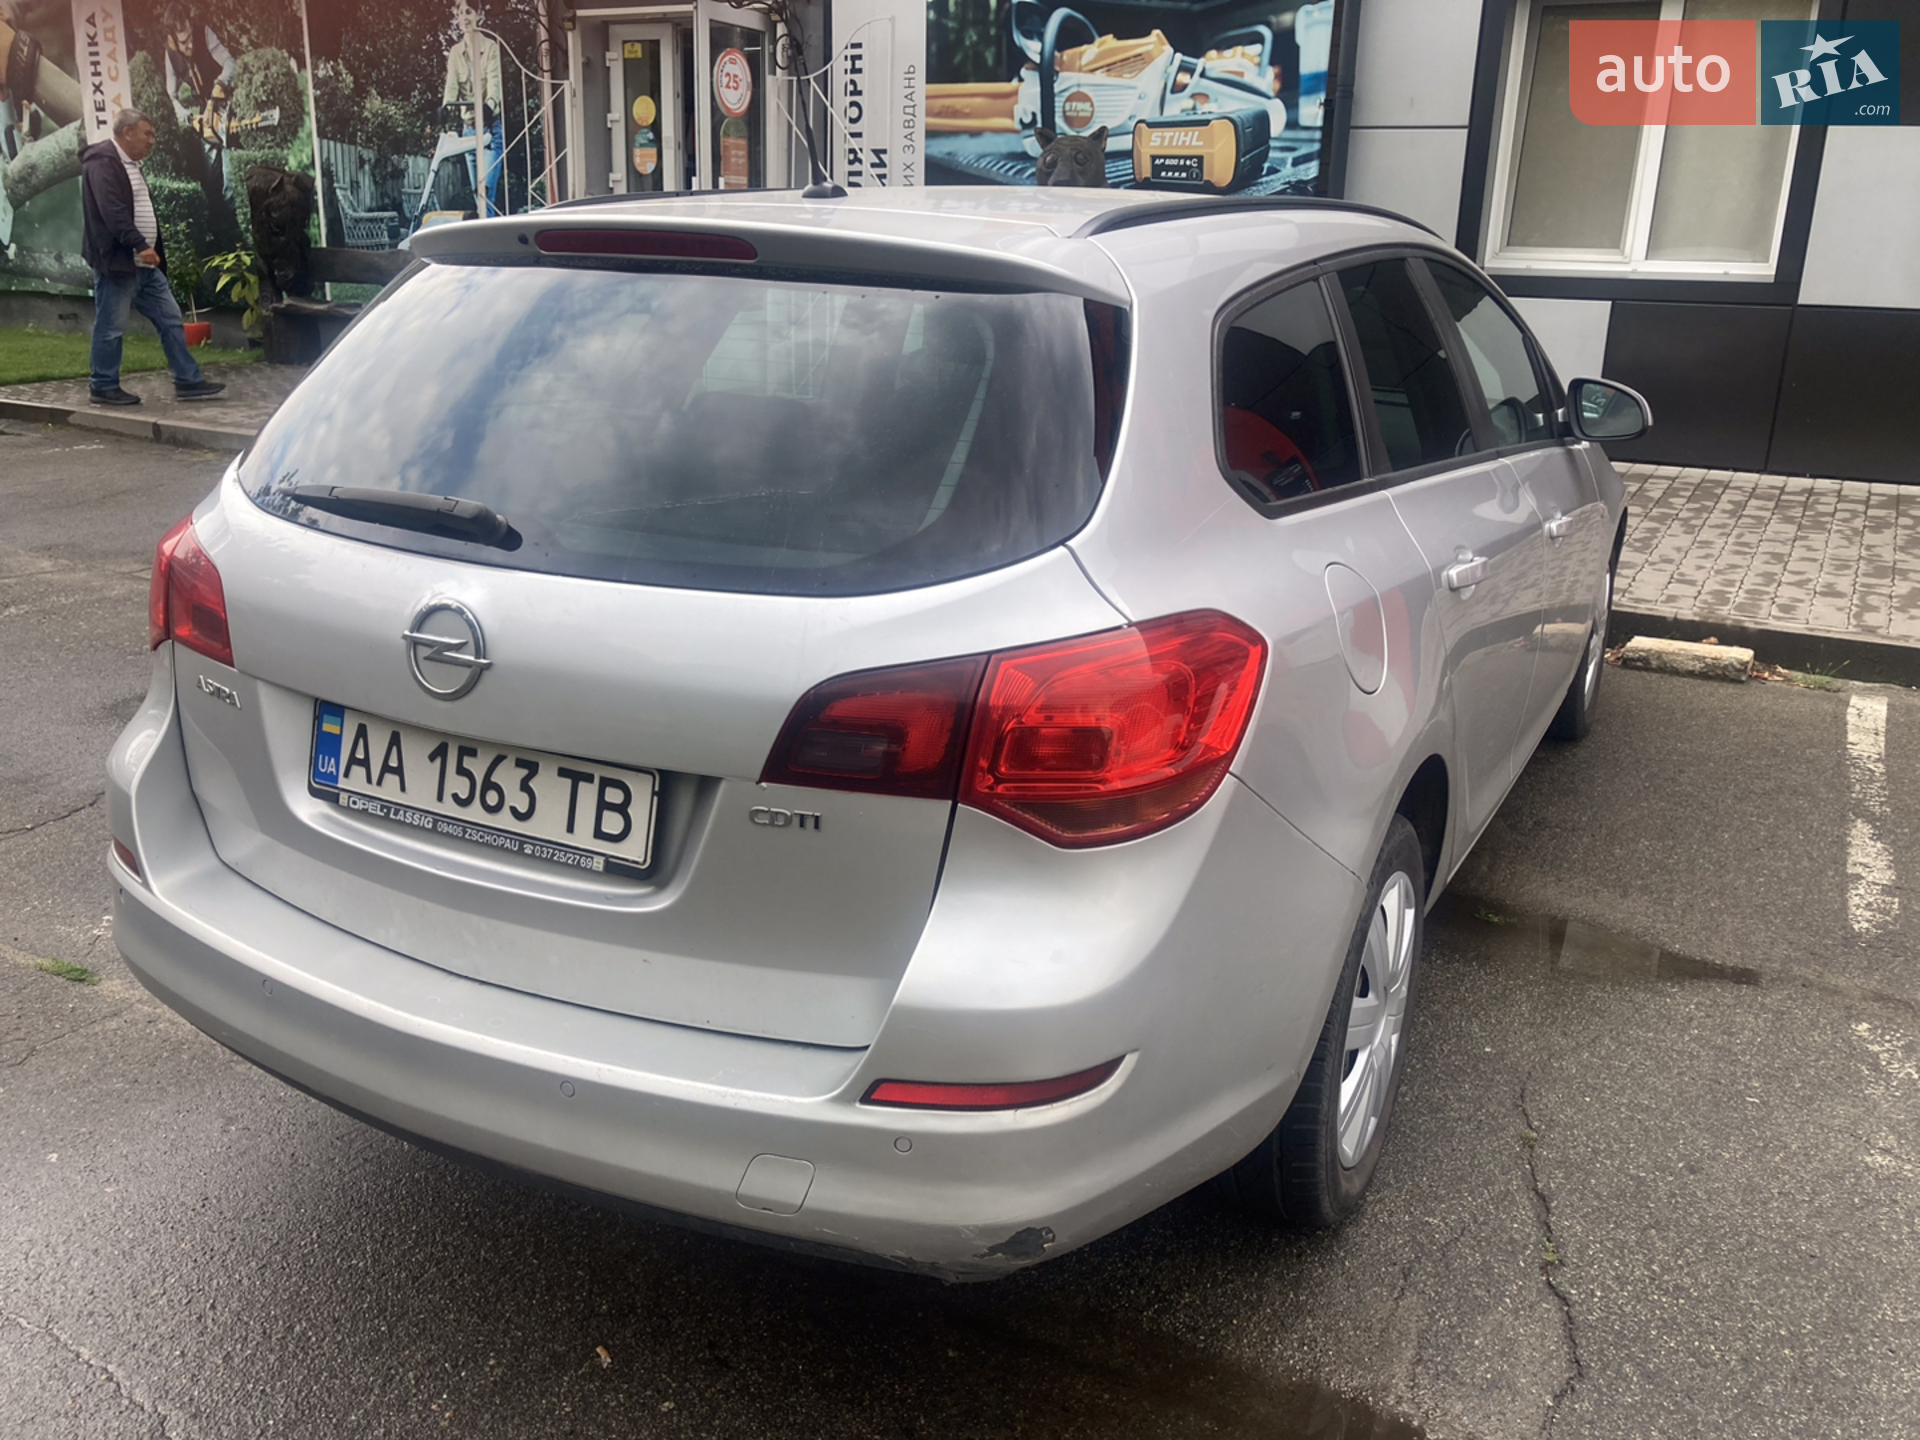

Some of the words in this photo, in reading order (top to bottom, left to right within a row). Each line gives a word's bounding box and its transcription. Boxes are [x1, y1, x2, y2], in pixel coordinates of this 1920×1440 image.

[101, 6, 119, 82] САДУ
[85, 11, 107, 130] ТЕХНІКА
[725, 72, 740, 91] 25
[902, 64, 917, 154] ЗАВДАНЬ
[1149, 131, 1204, 147] STIHL
[197, 675, 242, 709] ASTRA
[318, 754, 337, 776] UA
[343, 722, 406, 793] AA
[428, 741, 540, 822] 1563
[557, 767, 632, 843] TB
[389, 807, 434, 829] LASSIG
[464, 828, 519, 851] ZSCHOPAU
[750, 806, 822, 831] CDTI
